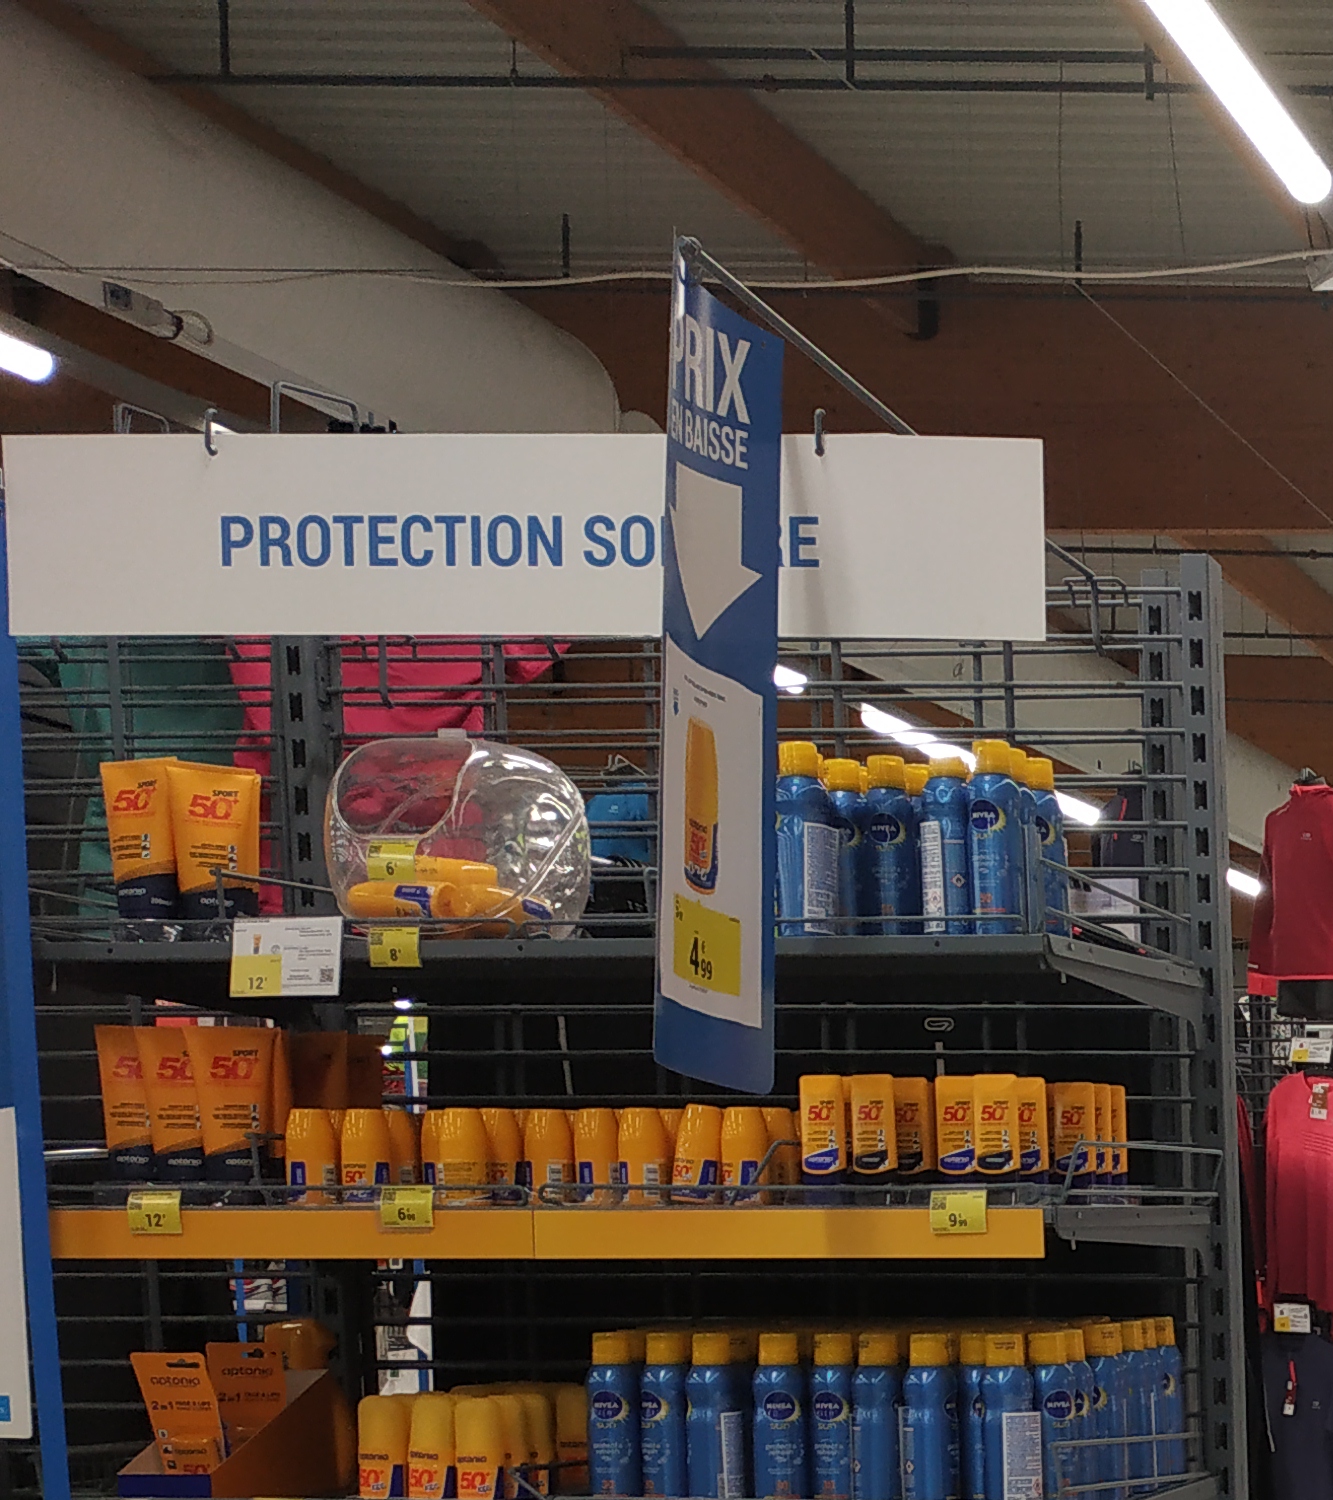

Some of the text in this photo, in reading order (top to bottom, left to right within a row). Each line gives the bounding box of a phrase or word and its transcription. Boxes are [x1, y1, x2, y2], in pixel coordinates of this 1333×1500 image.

[671, 313, 751, 425] PRIX
[686, 416, 749, 470] BAISSE
[220, 514, 565, 568] PROTECTION
[212, 789, 239, 798] SPORT
[971, 811, 996, 819] NIVEA
[150, 1376, 200, 1388] aptonia
[1047, 1400, 1072, 1410] NIVEA
